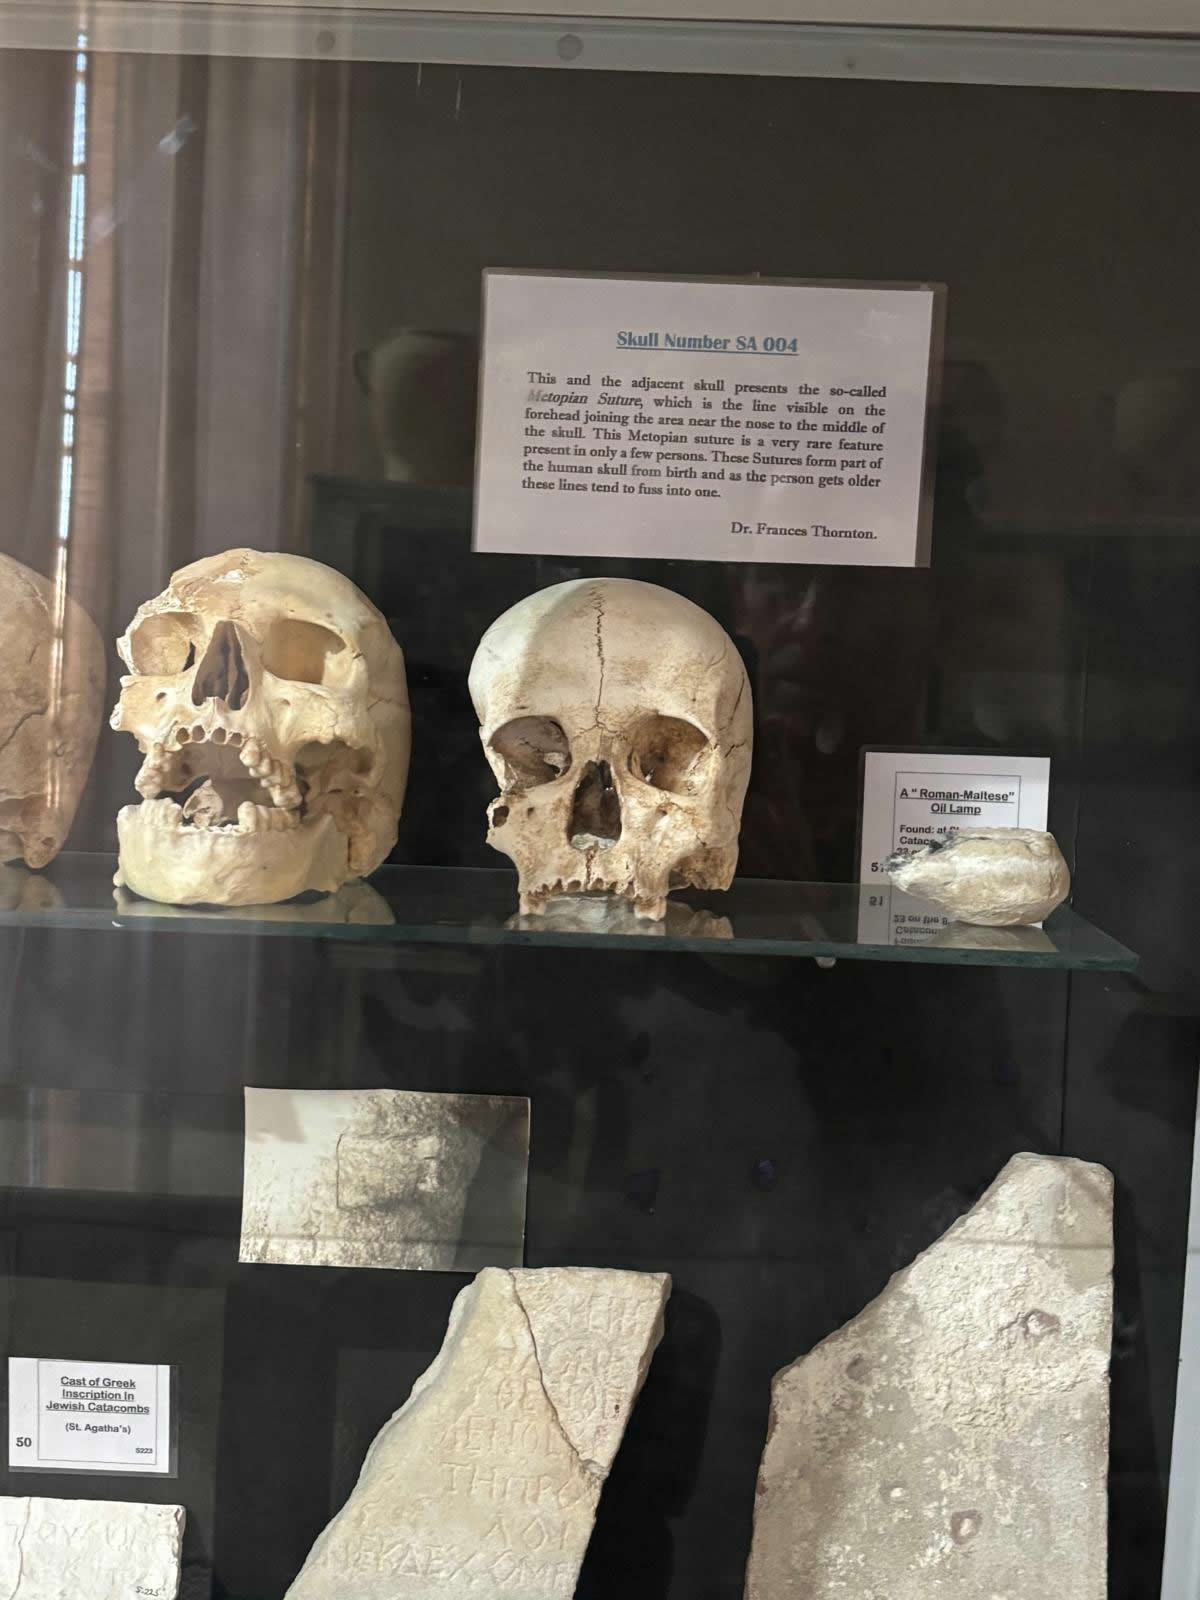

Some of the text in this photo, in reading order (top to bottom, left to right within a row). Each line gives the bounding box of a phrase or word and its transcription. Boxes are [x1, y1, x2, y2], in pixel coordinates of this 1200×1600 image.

[617, 331, 798, 352] Skull Number SA 004
[527, 372, 887, 398] This and the adjacent skull presents the so-called
[597, 393, 643, 409] Suture,
[653, 396, 692, 409] which
[702, 397, 712, 409] is
[722, 398, 743, 411] the
[752, 399, 776, 412] line
[786, 401, 828, 414] visible
[838, 405, 854, 415] on
[865, 404, 886, 416] the
[525, 408, 886, 433] forehead joining the area near the nose to the middle of
[525, 426, 883, 451] the skull. This Metopian suture is a very rare feature
[524, 445, 883, 471] present in only a few persons. These Sutures form part of
[523, 460, 881, 488] the human skull from birth and as the person gets older
[522, 477, 721, 498] these lines tend to fuss into one.
[731, 521, 877, 539] Dr. Frances Thornton.
[900, 788, 909, 798] A
[930, 803, 981, 816] Oil Lamp
[900, 824, 934, 835] Found:
[60, 1376, 136, 1388] Cast of Greek
[62, 1388, 135, 1401] Inscription In
[46, 1400, 150, 1413] Jewish Catacombs
[65, 1422, 131, 1435] (St. Agatha's)
[16, 1437, 32, 1448] 50
